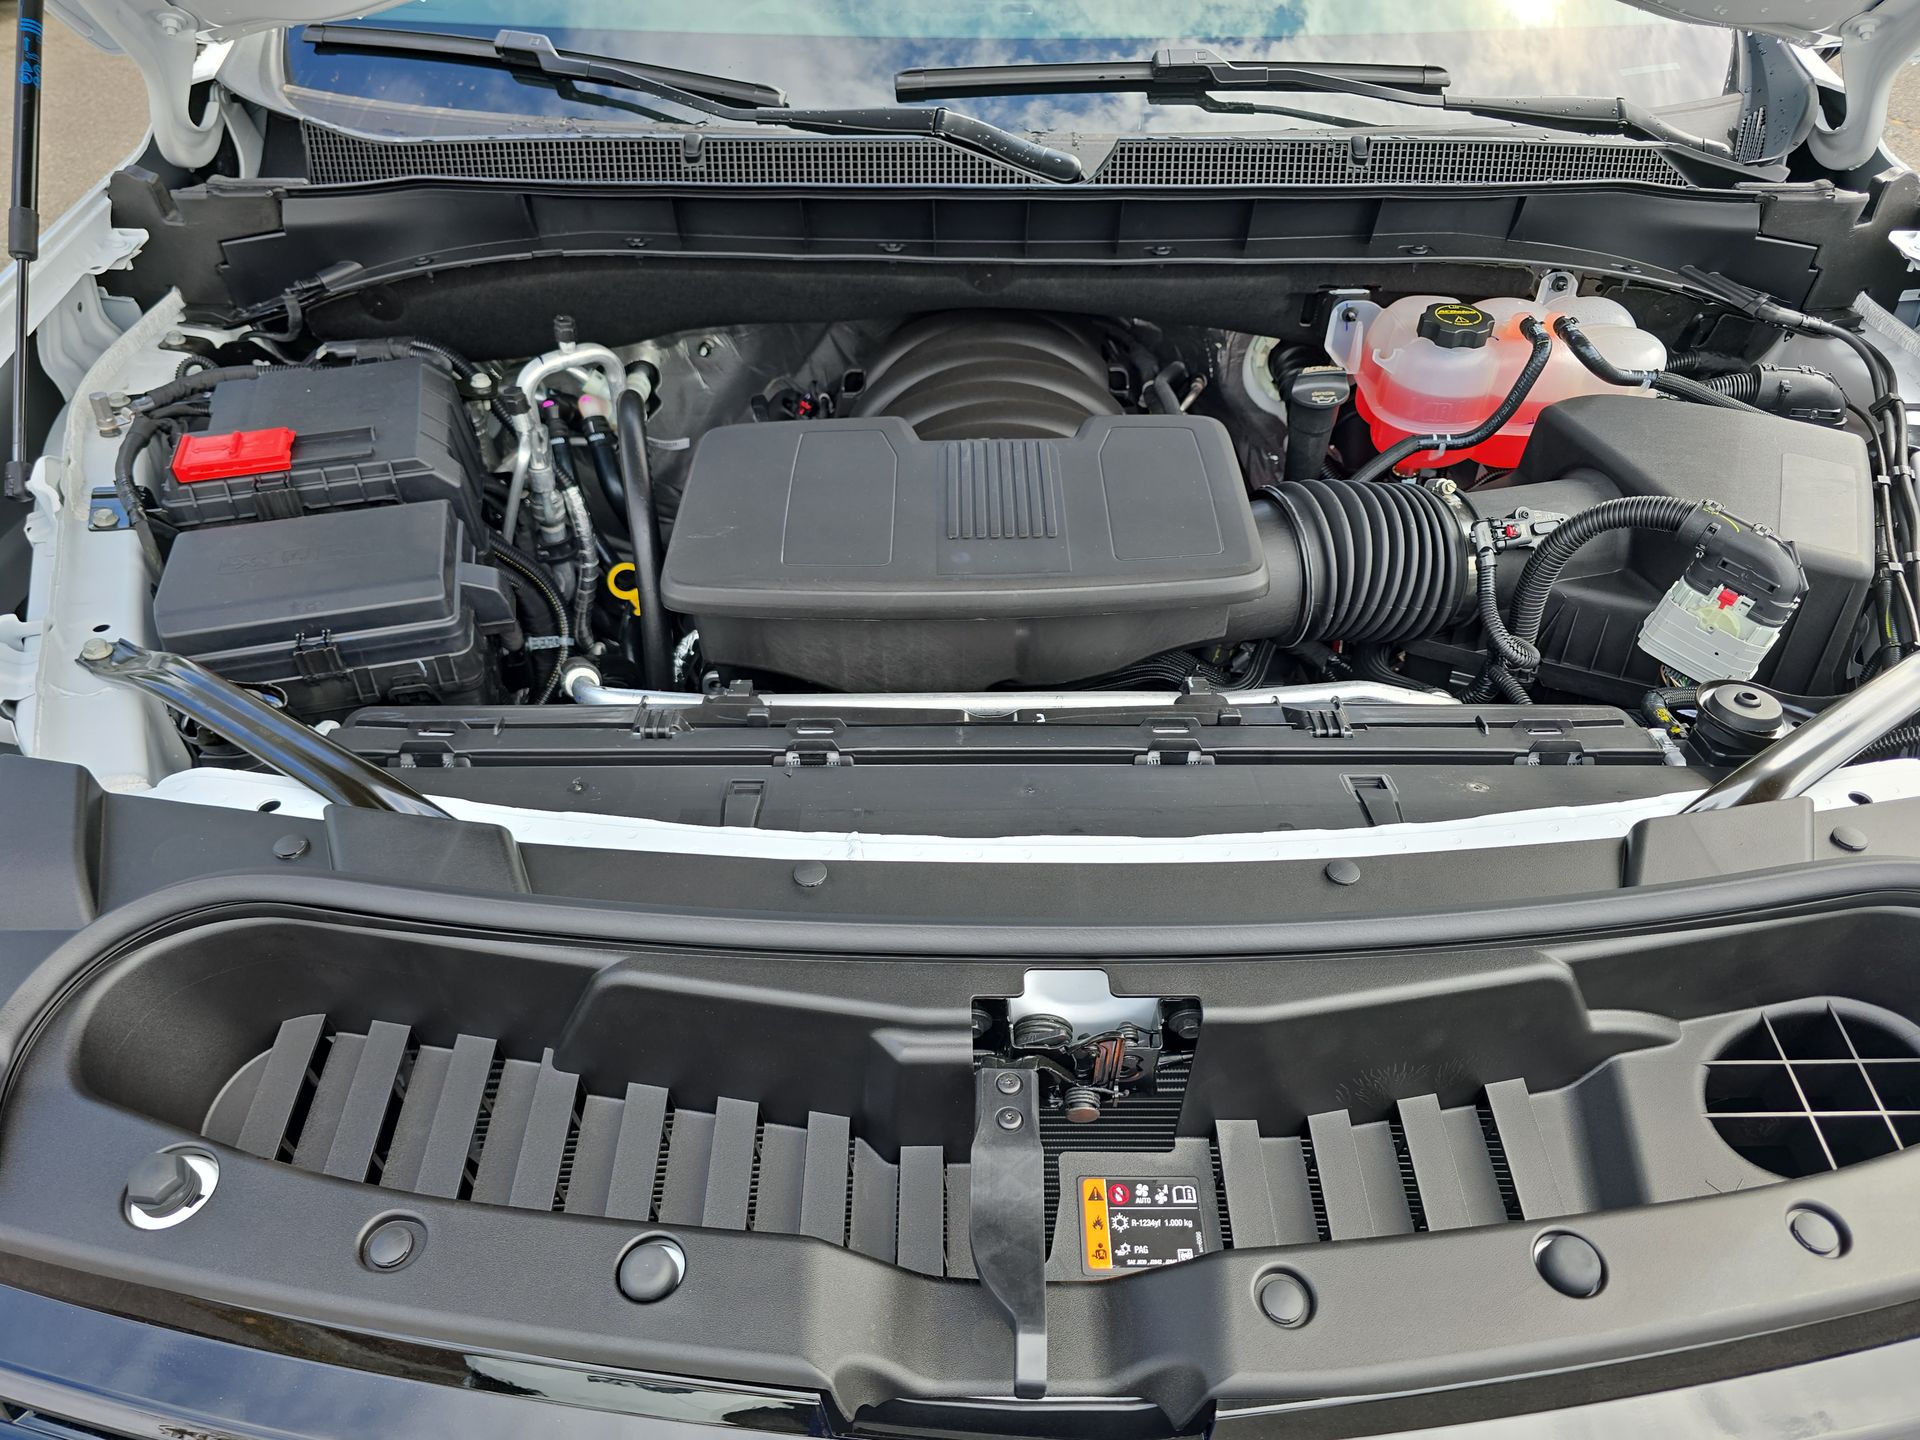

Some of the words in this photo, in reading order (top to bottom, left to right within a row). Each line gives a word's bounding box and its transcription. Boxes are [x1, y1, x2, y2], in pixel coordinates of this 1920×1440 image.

[1131, 1219, 1161, 1228] R-1234yf
[1164, 1218, 1183, 1227] 1.000
[1183, 1218, 1193, 1228] kg
[1134, 1245, 1149, 1254] PAG
